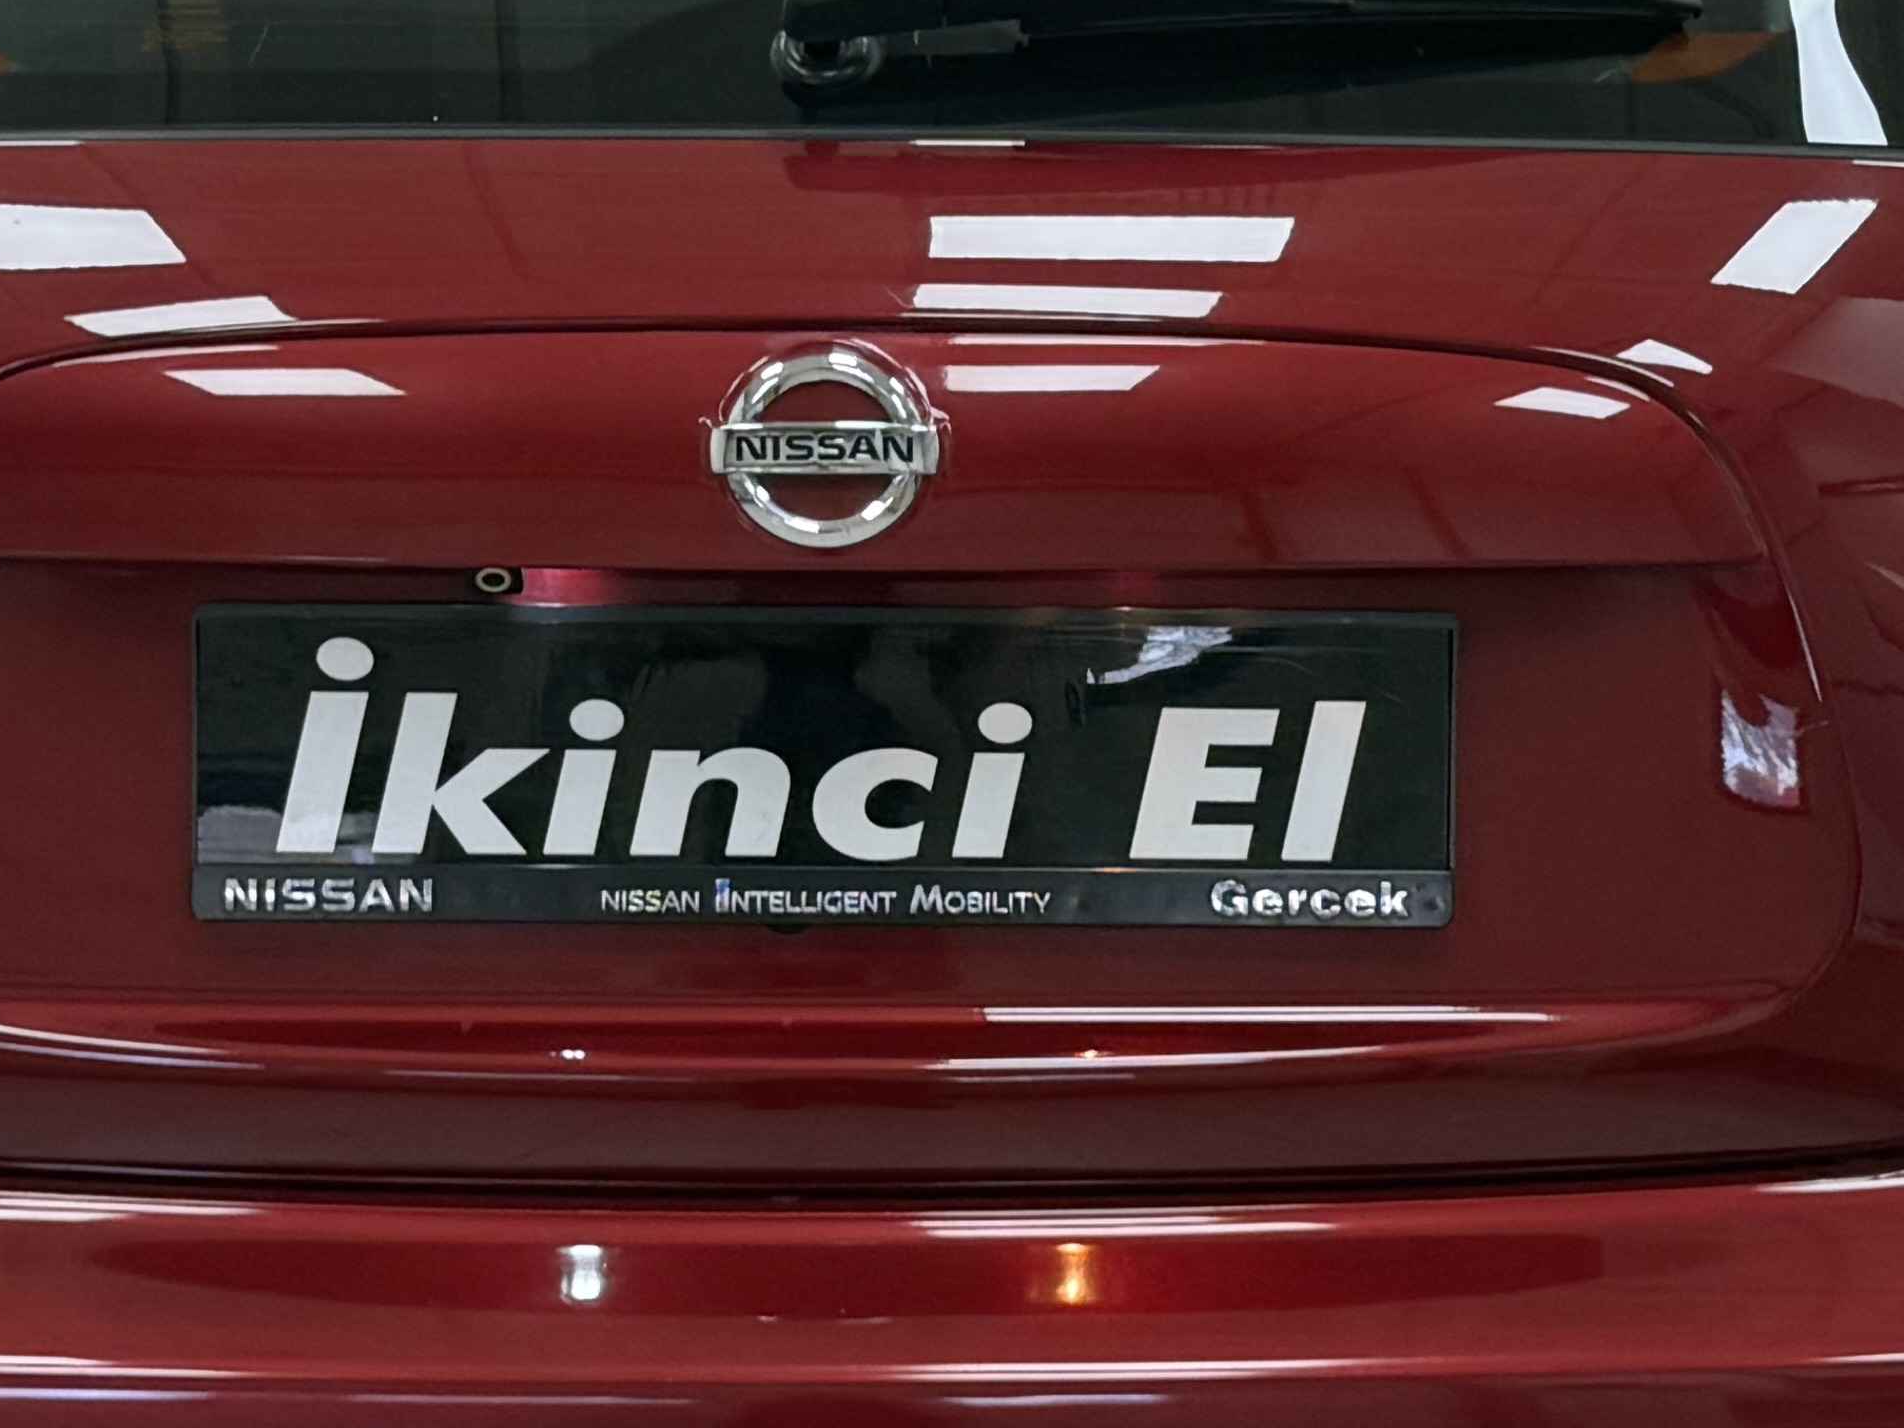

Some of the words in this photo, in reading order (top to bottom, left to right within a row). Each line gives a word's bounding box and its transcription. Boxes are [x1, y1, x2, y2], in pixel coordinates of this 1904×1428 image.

[735, 434, 914, 463] NISSAN
[1129, 699, 1368, 863] El
[224, 878, 433, 912] NISSAN
[601, 889, 700, 914] NISSAN
[1210, 879, 1408, 918] Gercek
